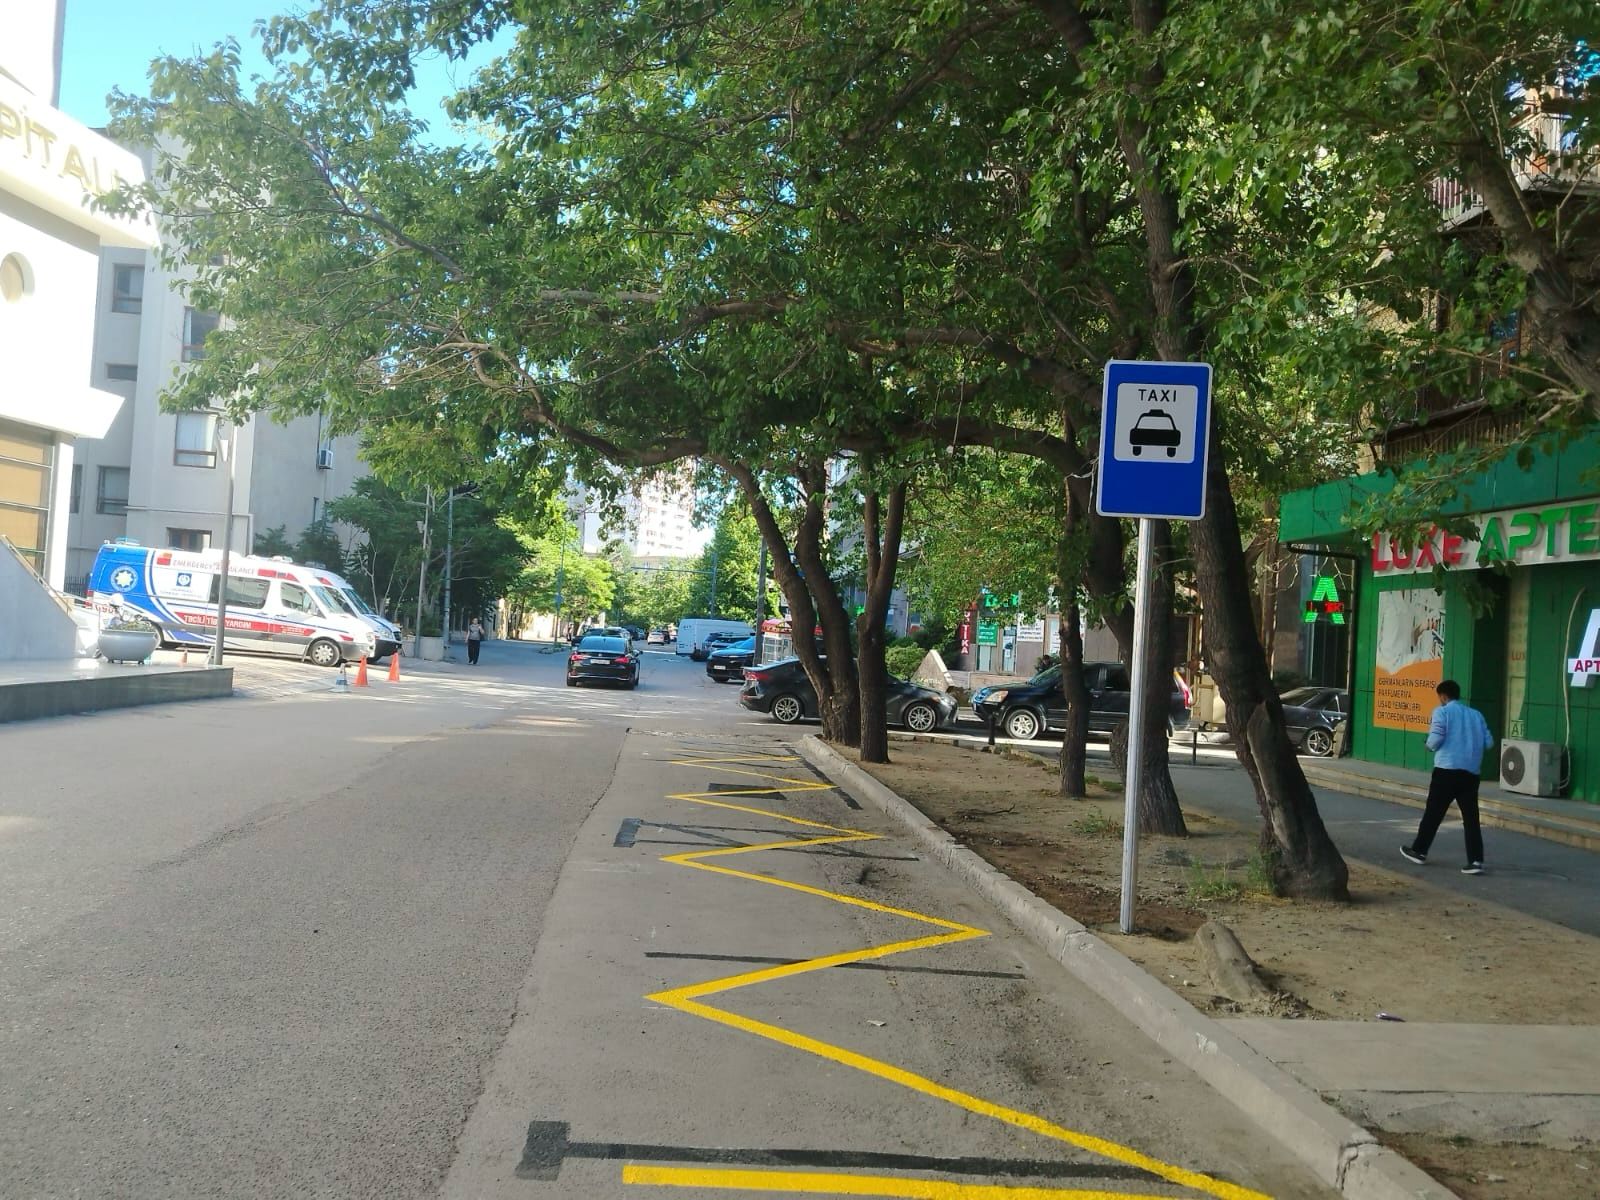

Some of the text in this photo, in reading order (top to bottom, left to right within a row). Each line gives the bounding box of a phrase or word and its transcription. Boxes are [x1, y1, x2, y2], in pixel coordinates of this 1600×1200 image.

[1138, 389, 1177, 402] TAXI
[1372, 502, 1600, 571] LUXE APTE
